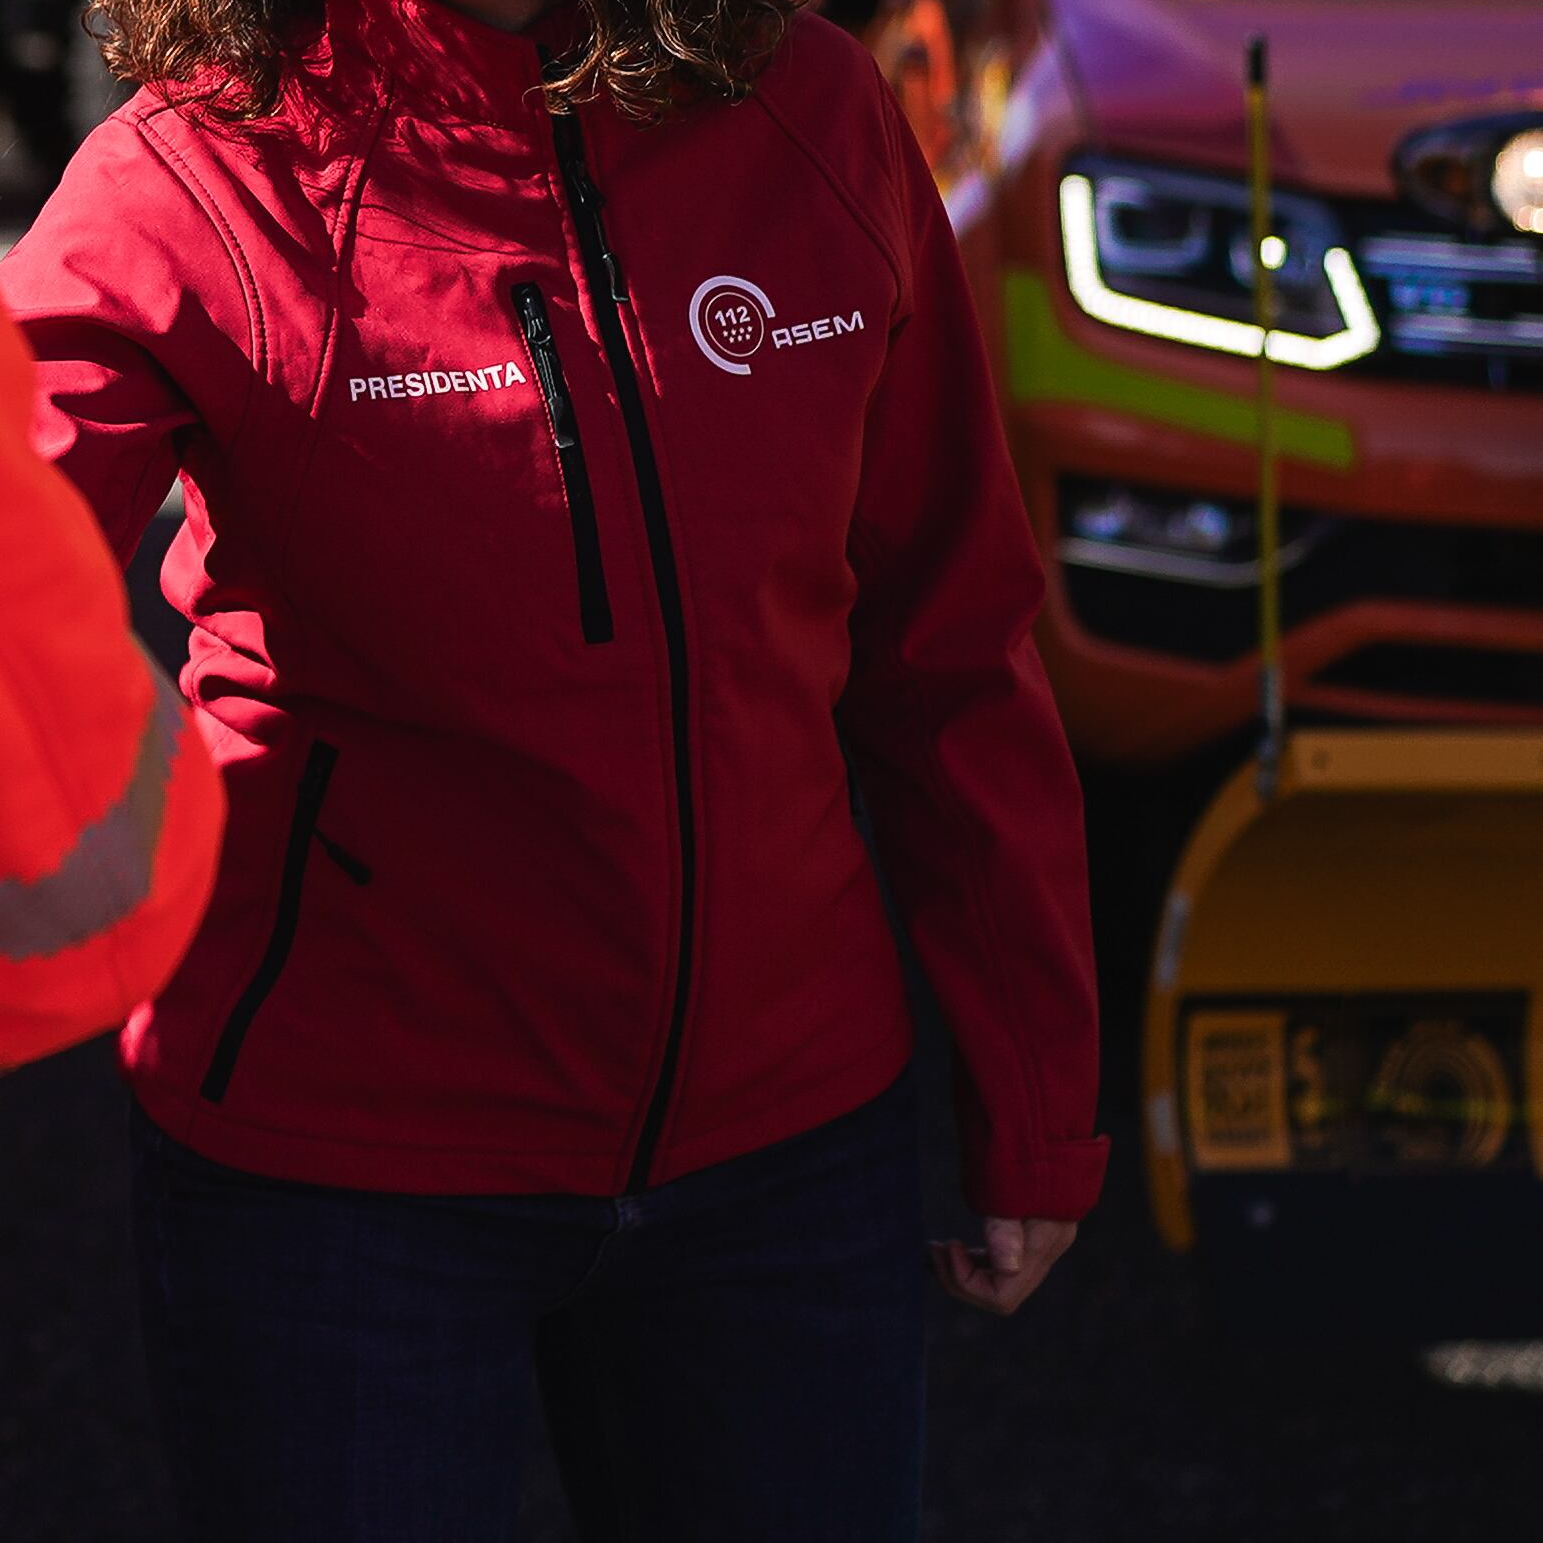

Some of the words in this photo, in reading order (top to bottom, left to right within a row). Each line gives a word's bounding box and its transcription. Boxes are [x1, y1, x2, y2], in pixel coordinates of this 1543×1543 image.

[714, 305, 751, 327] 112
[771, 310, 865, 349] ASEM
[349, 360, 527, 402] PRESIDENTA
